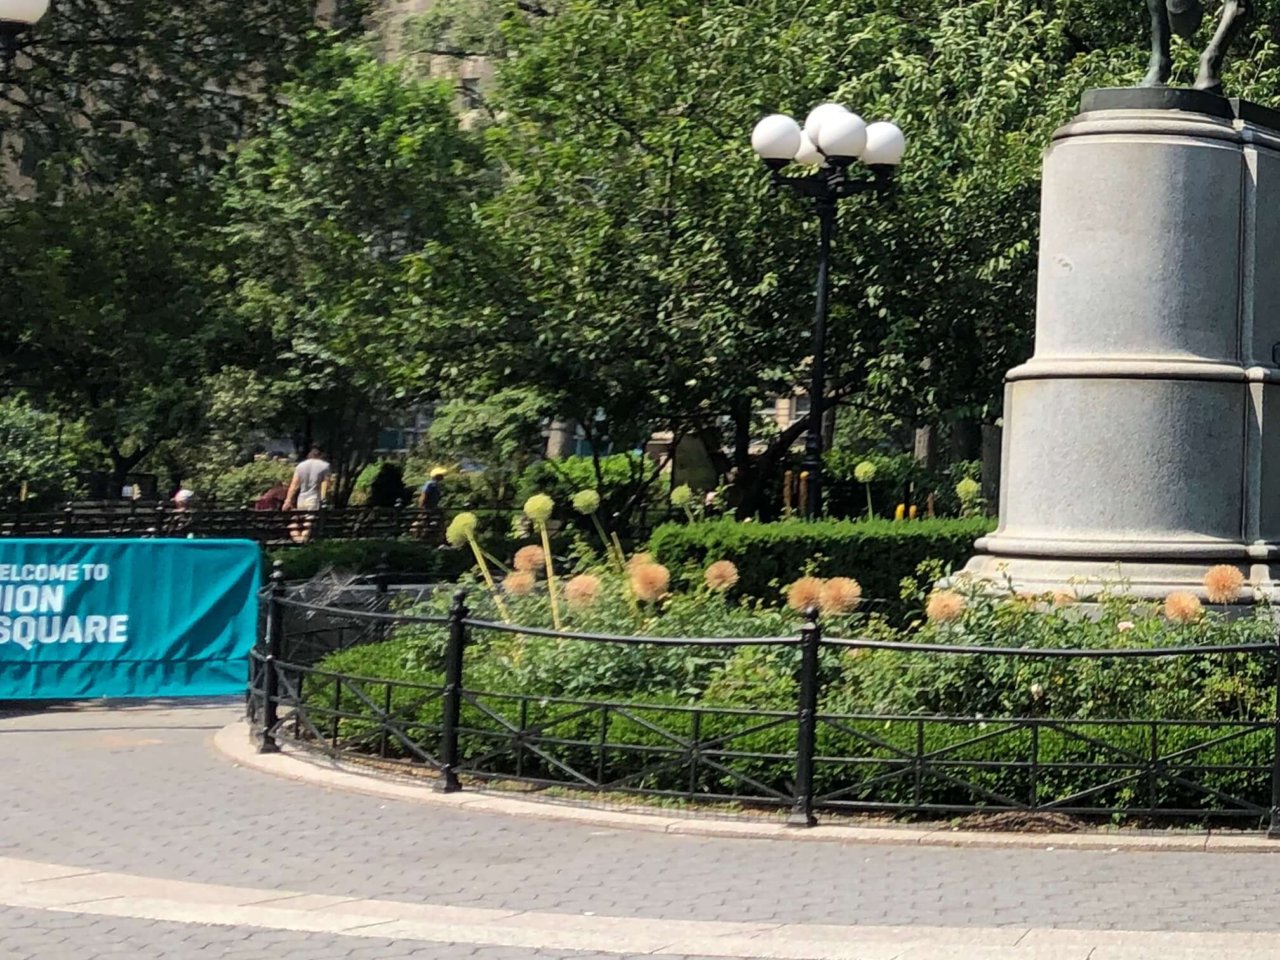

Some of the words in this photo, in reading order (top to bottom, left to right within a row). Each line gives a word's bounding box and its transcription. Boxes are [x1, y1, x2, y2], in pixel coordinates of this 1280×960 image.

[0, 564, 79, 581] ELCOME
[82, 564, 109, 581] TO
[0, 585, 64, 613] ION
